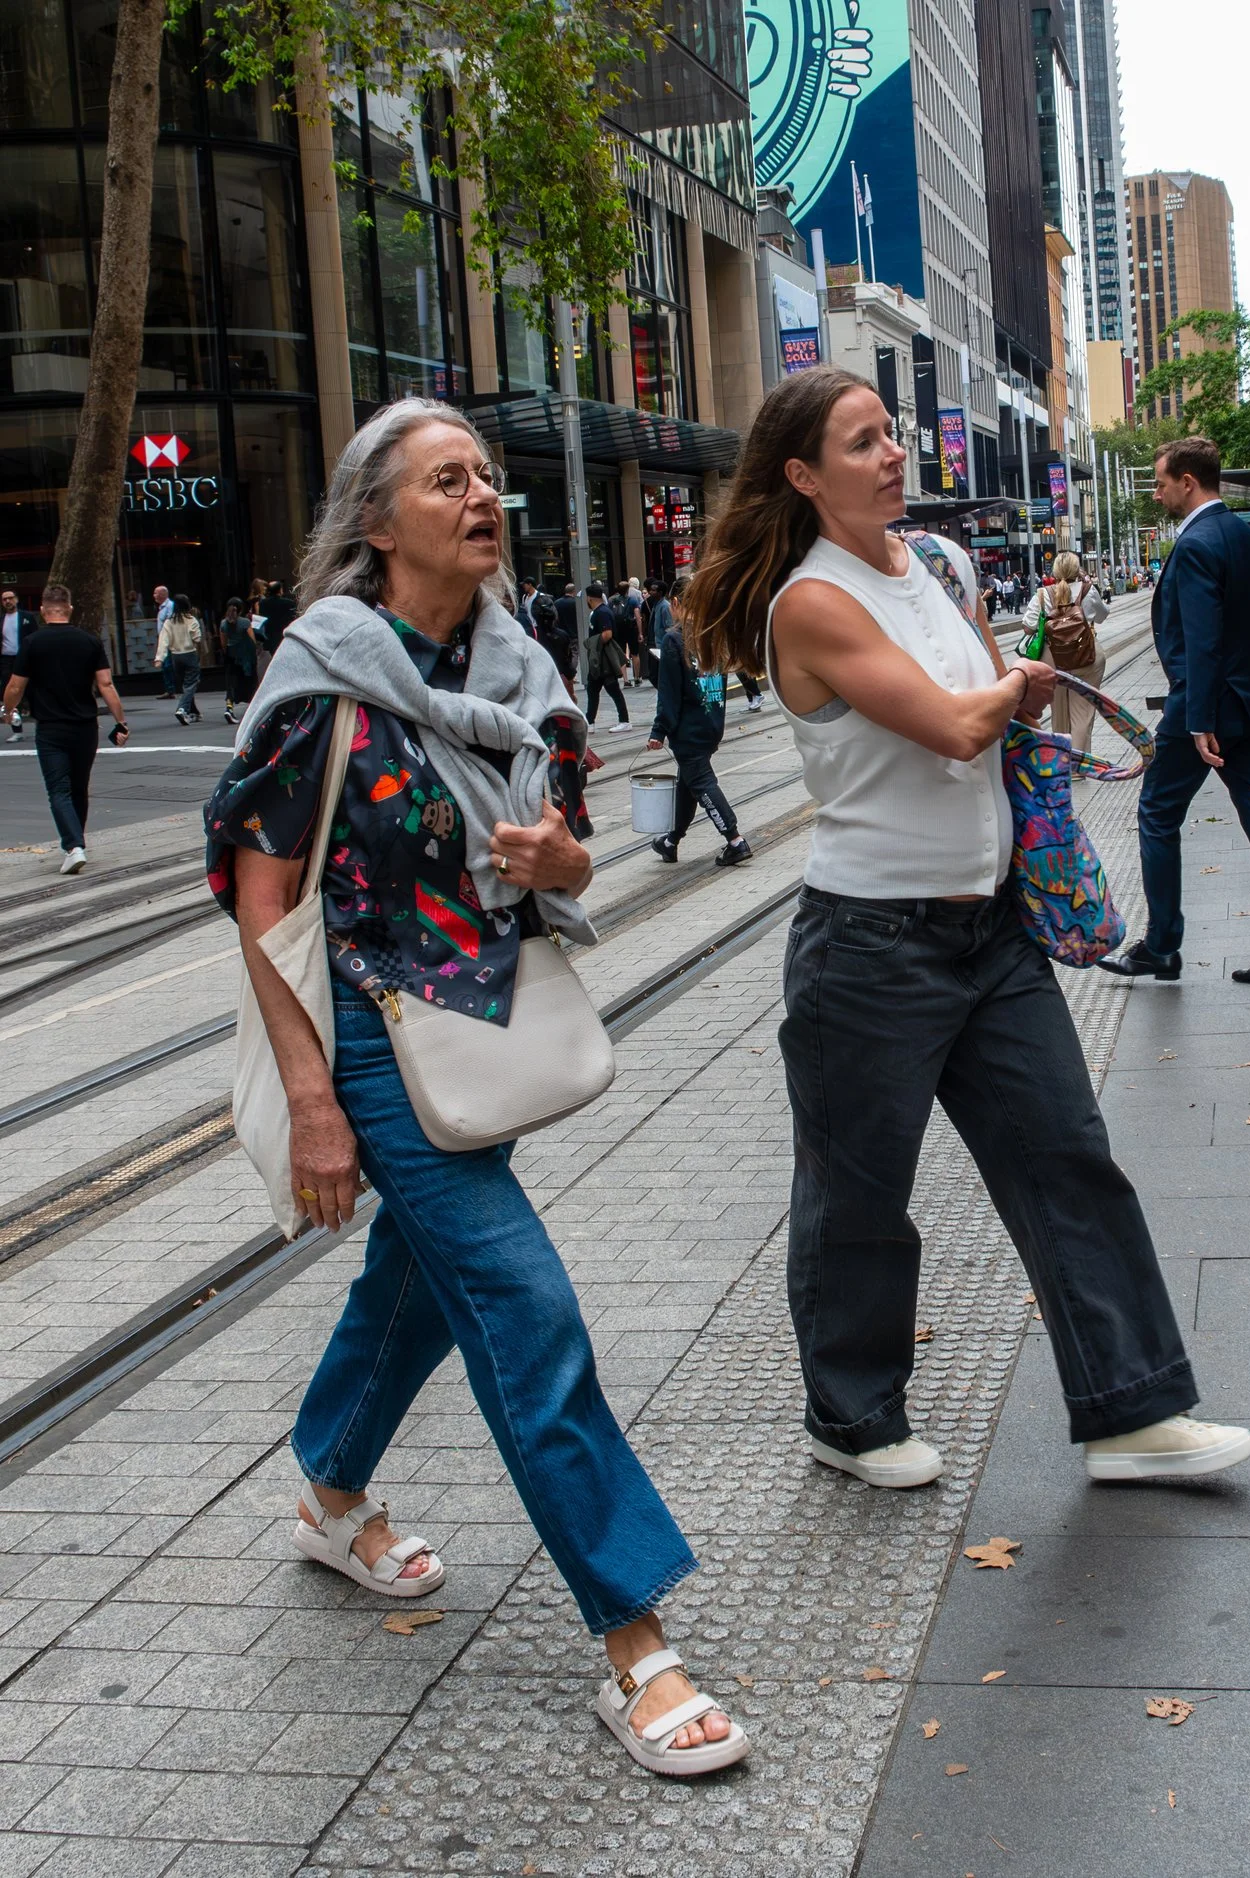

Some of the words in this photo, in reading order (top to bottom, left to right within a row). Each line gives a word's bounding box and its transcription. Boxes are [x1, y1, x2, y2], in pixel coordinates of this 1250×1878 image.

[1162, 197, 1186, 205] SEASONS
[1165, 203, 1185, 211] HOTEL
[784, 340, 816, 352] GUYS
[785, 352, 817, 363] DOLLS
[941, 416, 963, 425] GUYS
[920, 426, 935, 455] NIKE
